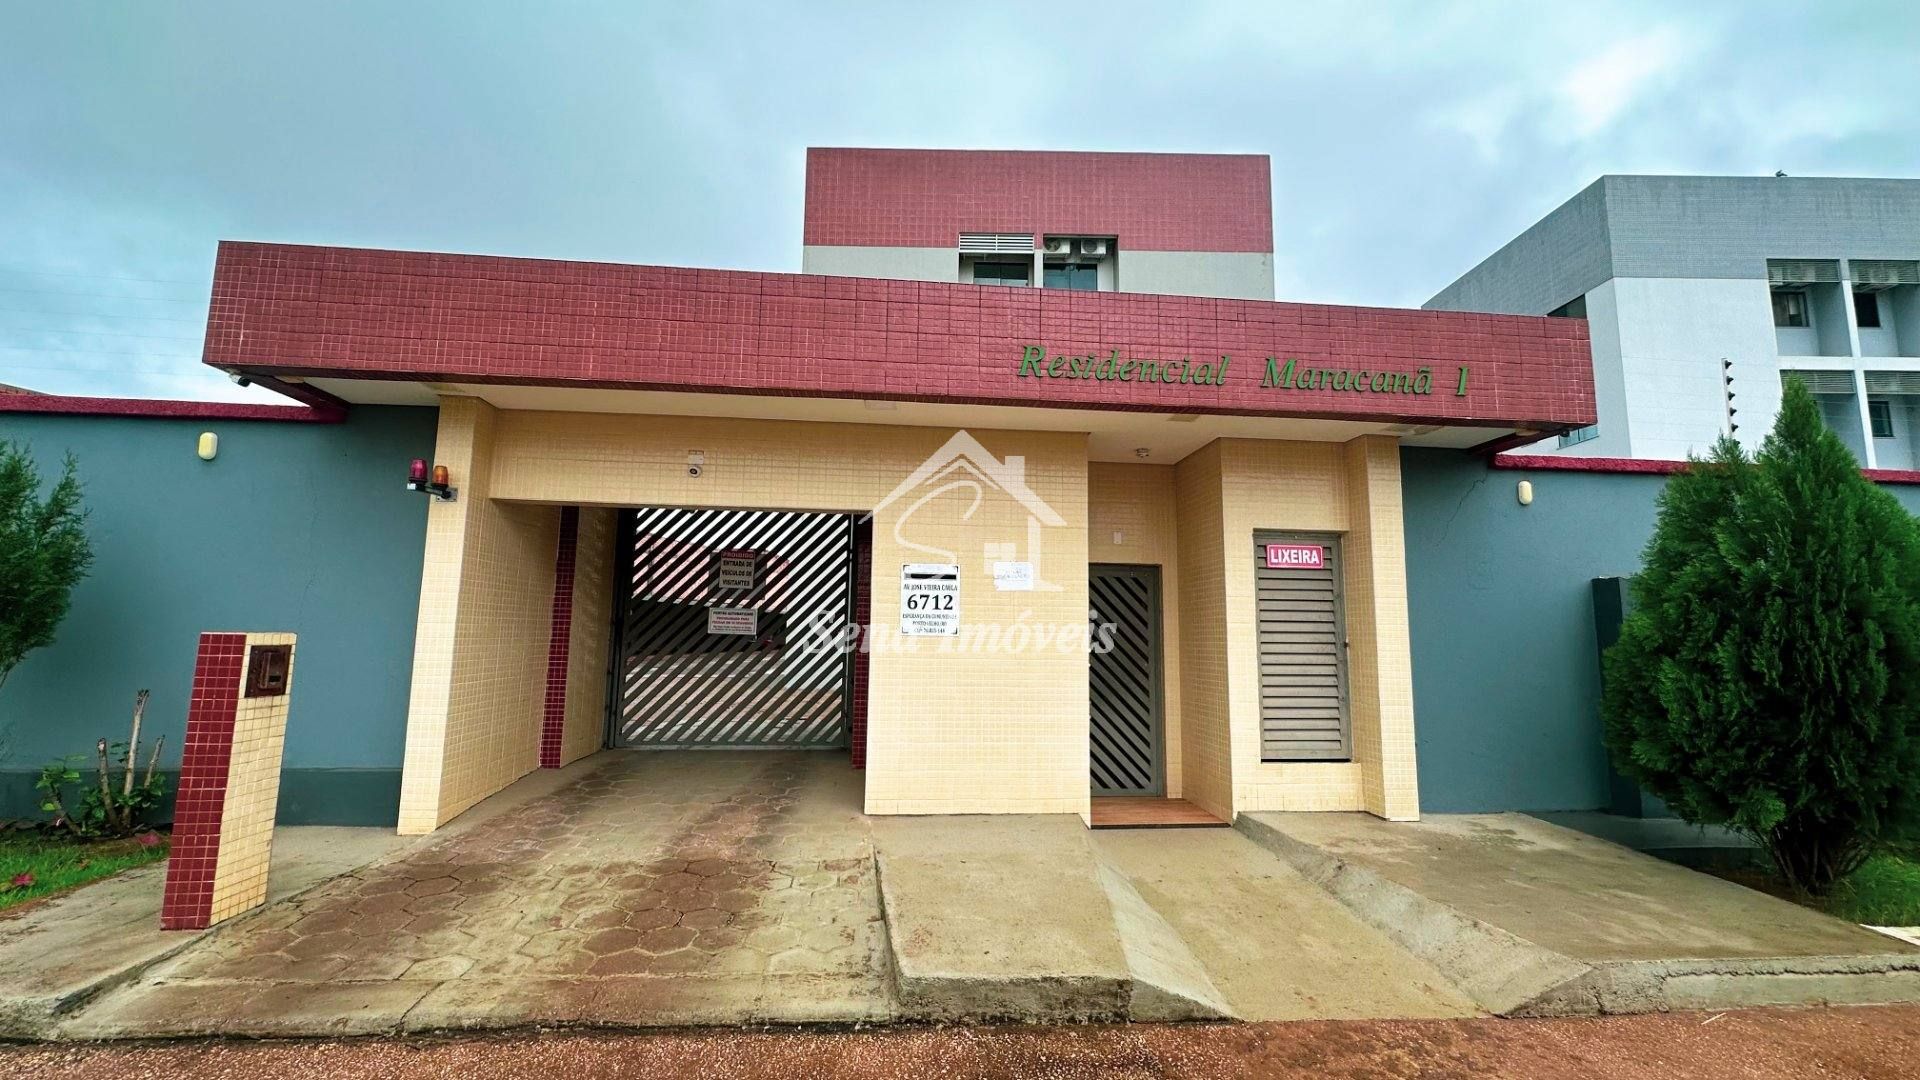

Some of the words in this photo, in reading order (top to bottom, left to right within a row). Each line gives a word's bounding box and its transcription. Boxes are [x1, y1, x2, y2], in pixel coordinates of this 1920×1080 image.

[1017, 344, 1231, 387] Residencial
[1260, 355, 1434, 395] Maracanã
[1270, 549, 1320, 564] LIXEIRA
[907, 594, 953, 610] 6712
